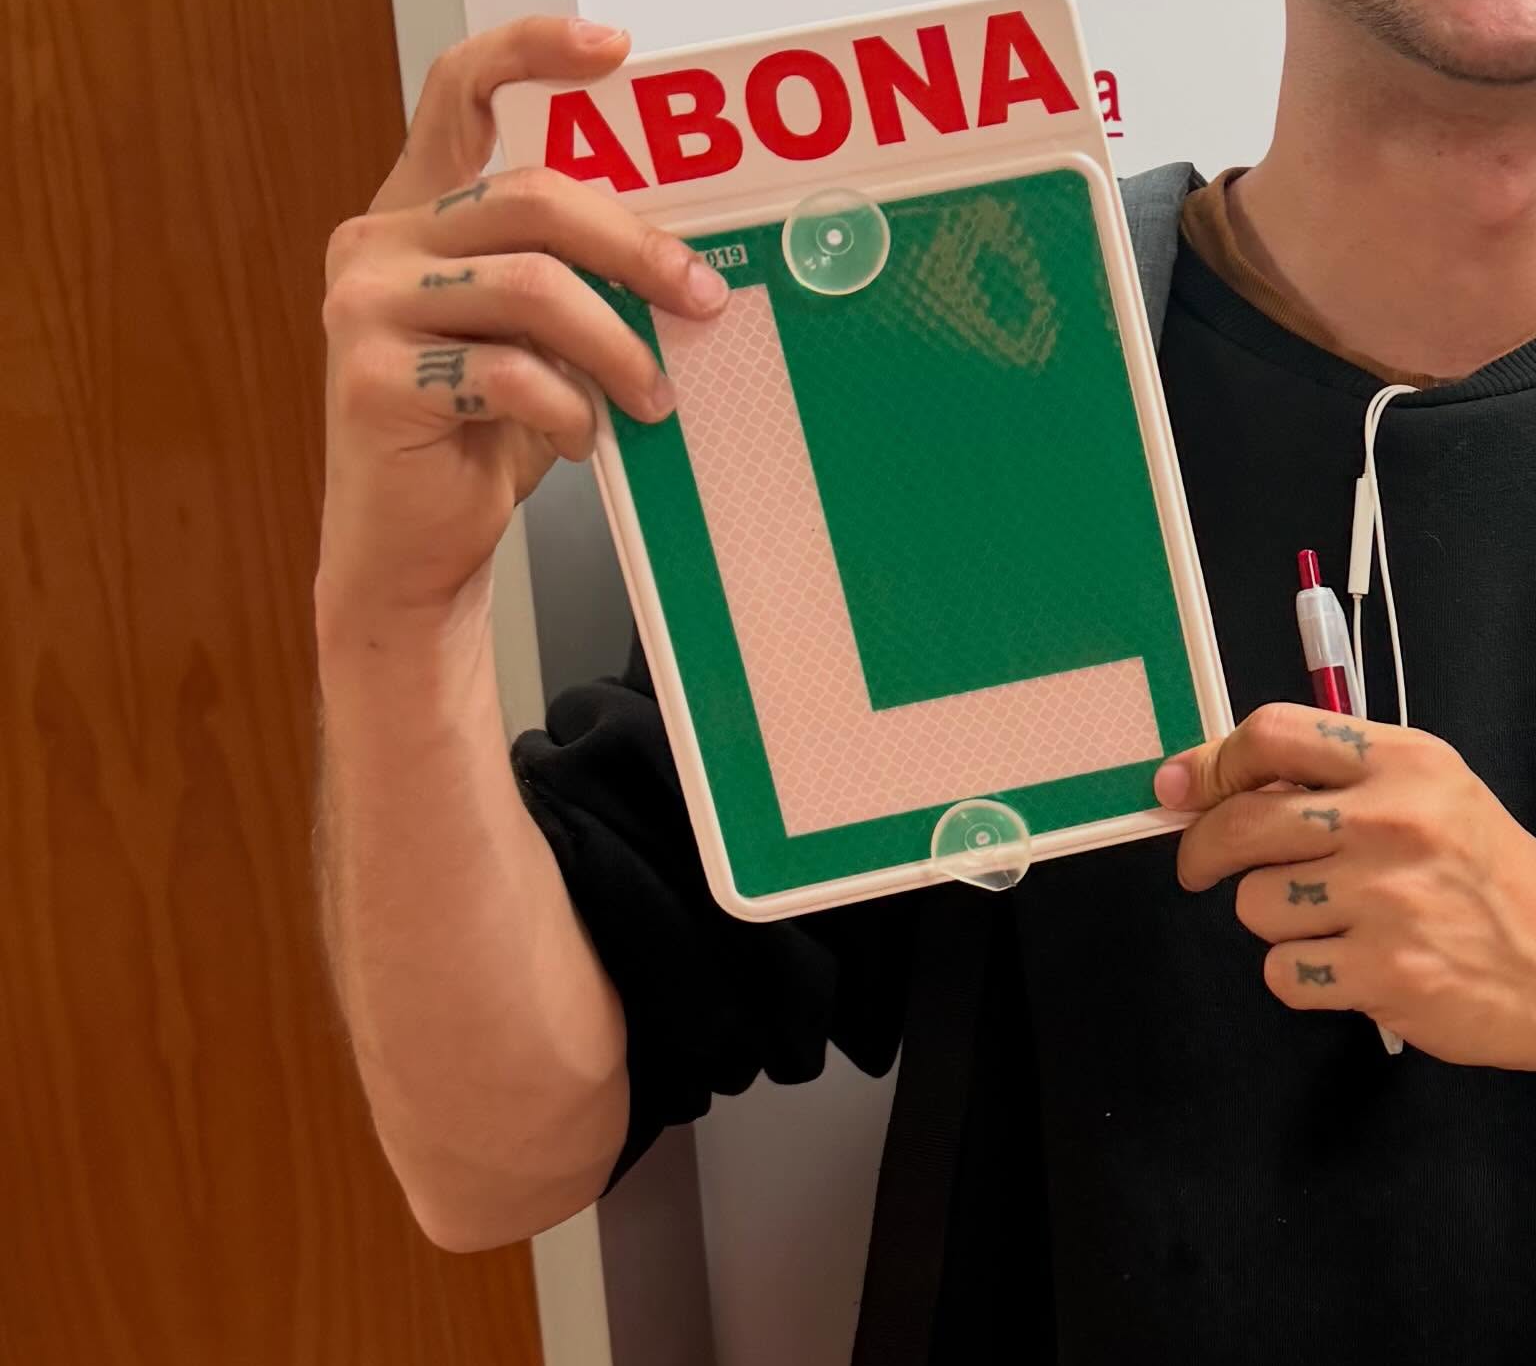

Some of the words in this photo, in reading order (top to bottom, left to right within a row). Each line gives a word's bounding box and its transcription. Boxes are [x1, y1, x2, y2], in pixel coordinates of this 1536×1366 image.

[544, 9, 1080, 194] ABONA
[704, 246, 743, 267] 019
[649, 283, 1164, 839] L
